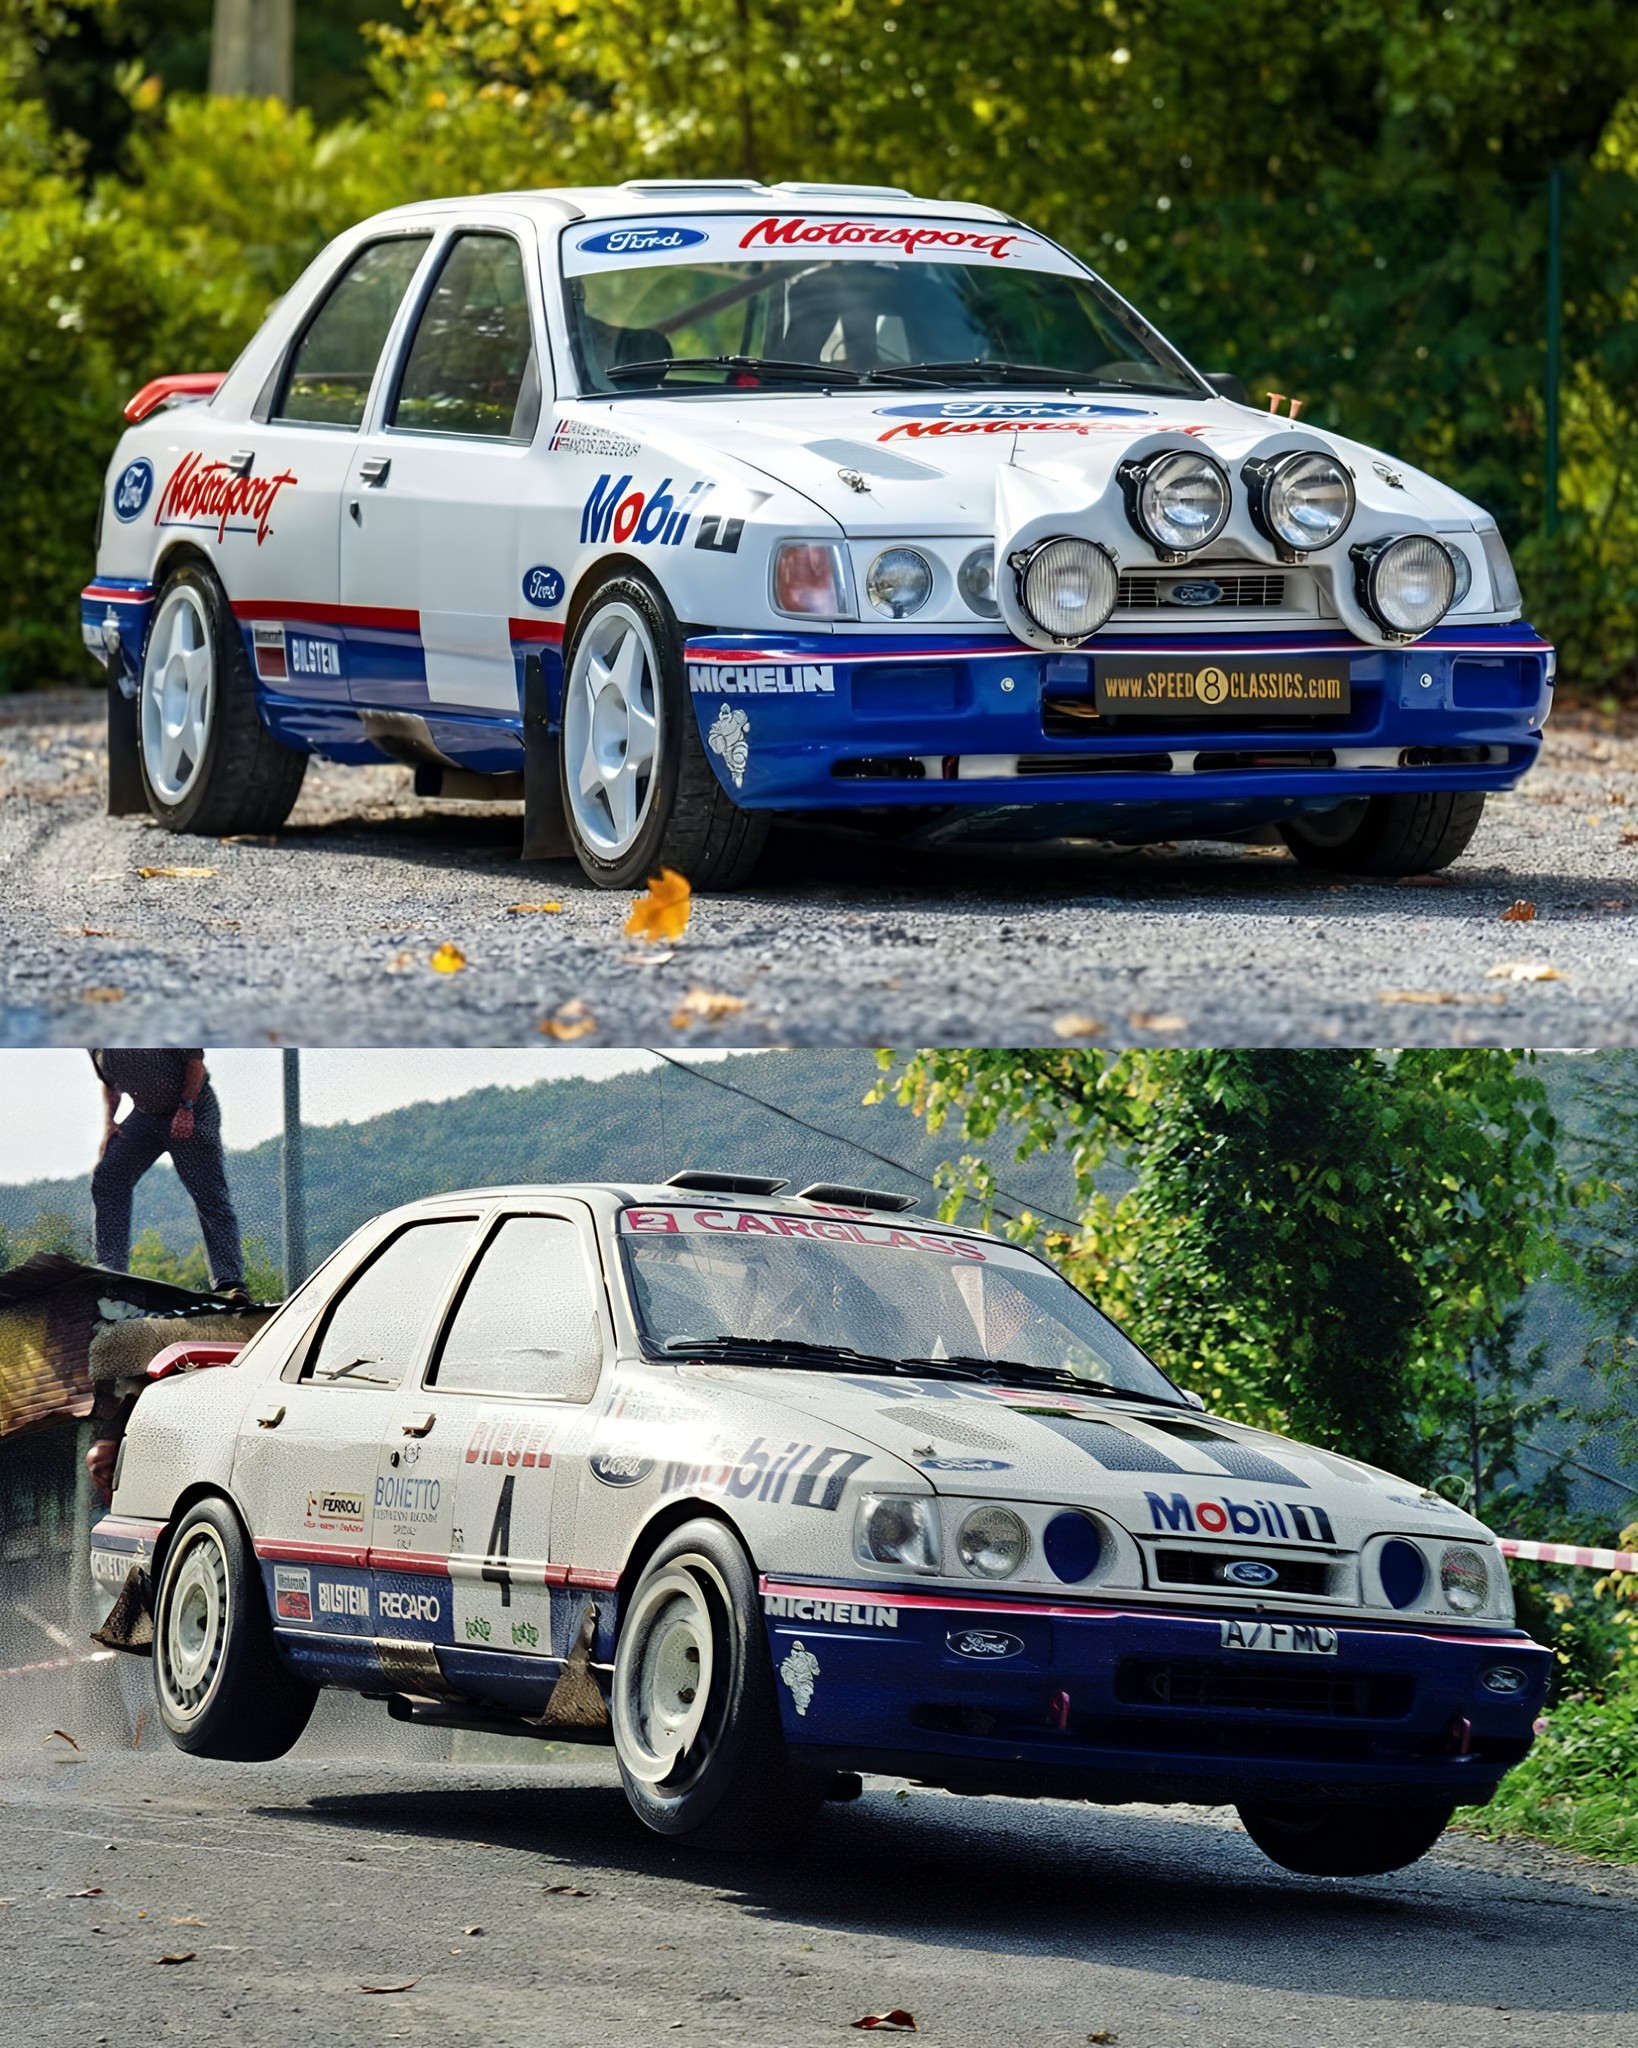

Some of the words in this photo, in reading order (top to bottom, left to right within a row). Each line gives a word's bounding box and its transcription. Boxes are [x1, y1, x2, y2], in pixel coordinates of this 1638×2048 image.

[606, 229, 683, 251] Ford
[738, 218, 1017, 259] Motorsport
[940, 402, 1103, 417] Ford
[580, 474, 716, 546] Mobil
[689, 665, 835, 693] MICHELIN
[693, 1212, 987, 1261] CARGLASS
[1144, 1491, 1290, 1539] Mobil
[482, 1475, 515, 1607] 4
[379, 1591, 440, 1622] RECARO
[765, 1595, 898, 1627] MICHELIN
